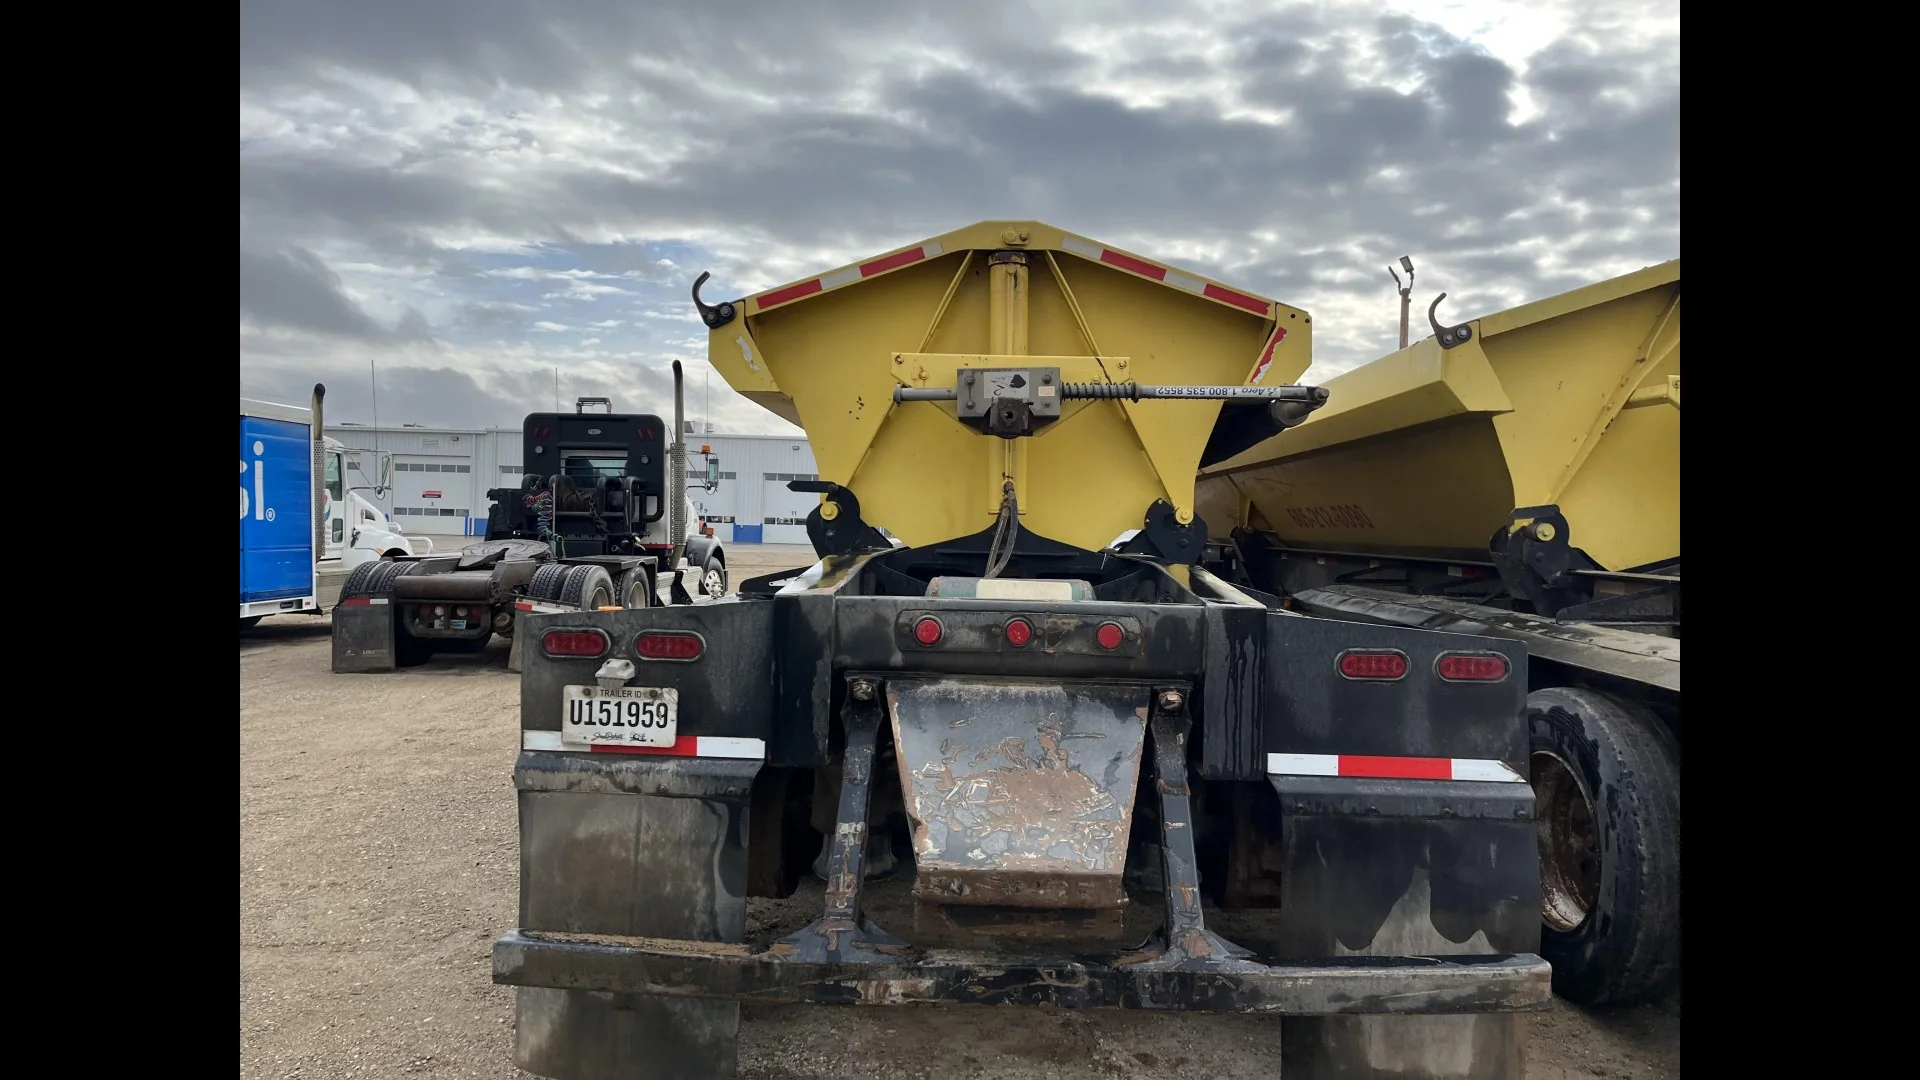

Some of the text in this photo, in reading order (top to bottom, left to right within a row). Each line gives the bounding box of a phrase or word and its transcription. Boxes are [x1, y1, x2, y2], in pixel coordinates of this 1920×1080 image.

[1158, 387, 1265, 396] Aero 1.800.535.8552
[600, 689, 642, 698] TRAILER ID
[570, 699, 668, 728] U151959
